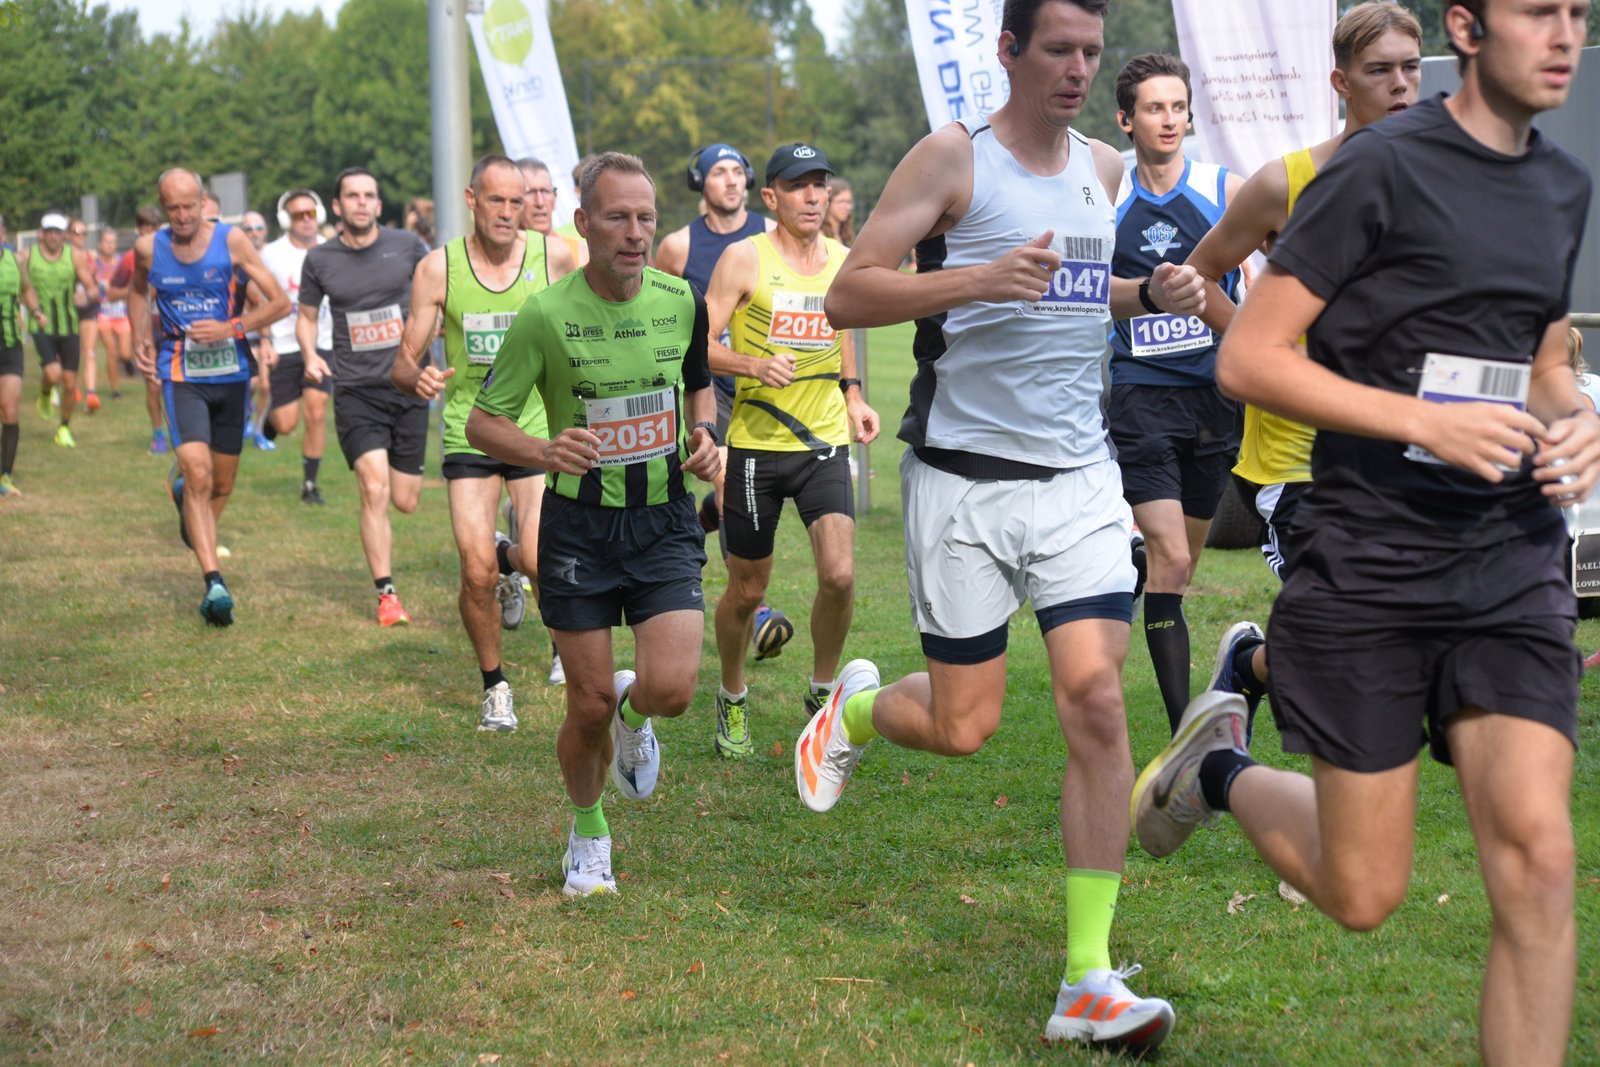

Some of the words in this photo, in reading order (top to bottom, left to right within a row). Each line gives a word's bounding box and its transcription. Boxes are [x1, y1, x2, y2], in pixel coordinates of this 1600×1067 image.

[651, 279, 686, 297] BIORACER
[352, 322, 401, 342] 2013
[583, 328, 604, 337] press
[614, 327, 647, 340] Athlex
[775, 315, 834, 338] 2019
[1138, 315, 1205, 343] 1099
[469, 333, 504, 354] 30
[190, 350, 234, 369] 3019
[582, 358, 610, 366] EXPERTS
[596, 416, 668, 453] 2051
[599, 447, 671, 465] www.krekenlopers.be
[1147, 620, 1175, 630] cep
